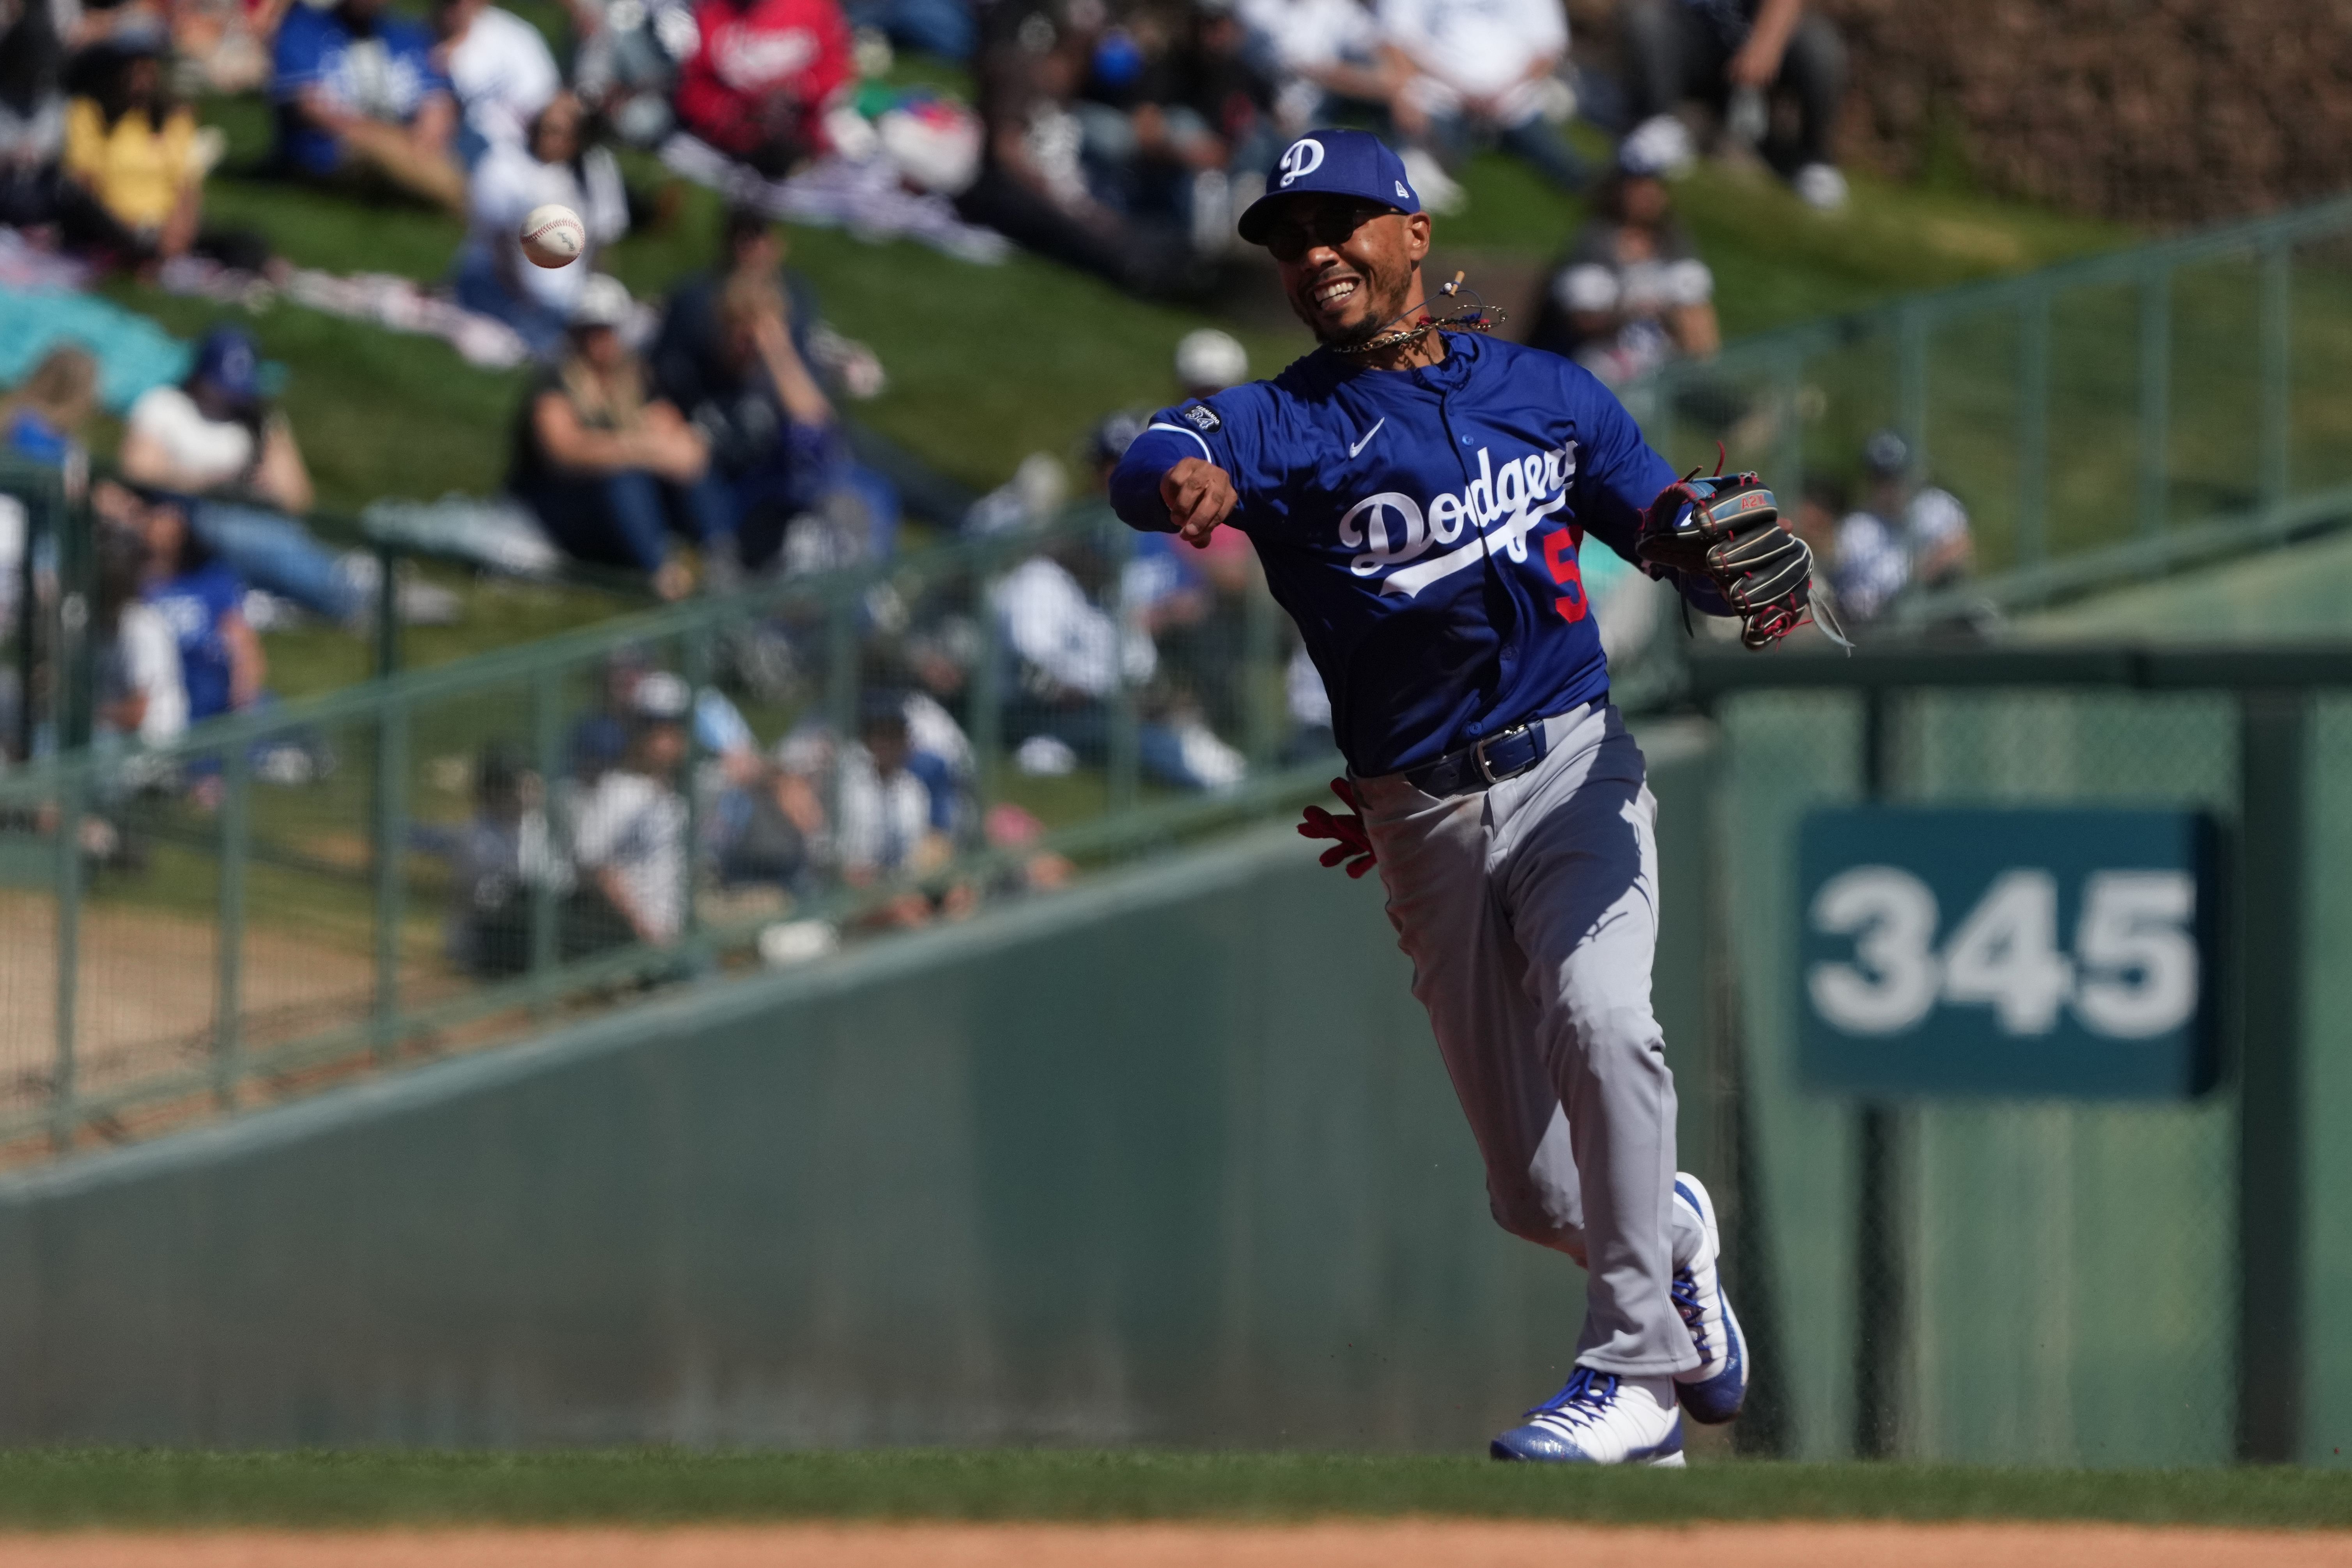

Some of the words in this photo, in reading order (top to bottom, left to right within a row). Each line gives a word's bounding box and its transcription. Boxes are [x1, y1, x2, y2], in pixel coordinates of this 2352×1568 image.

[1280, 138, 1325, 188] D
[1185, 409, 1214, 430] 34
[1196, 405, 1220, 425] FERNANDO
[1809, 865, 2197, 1036] 345
